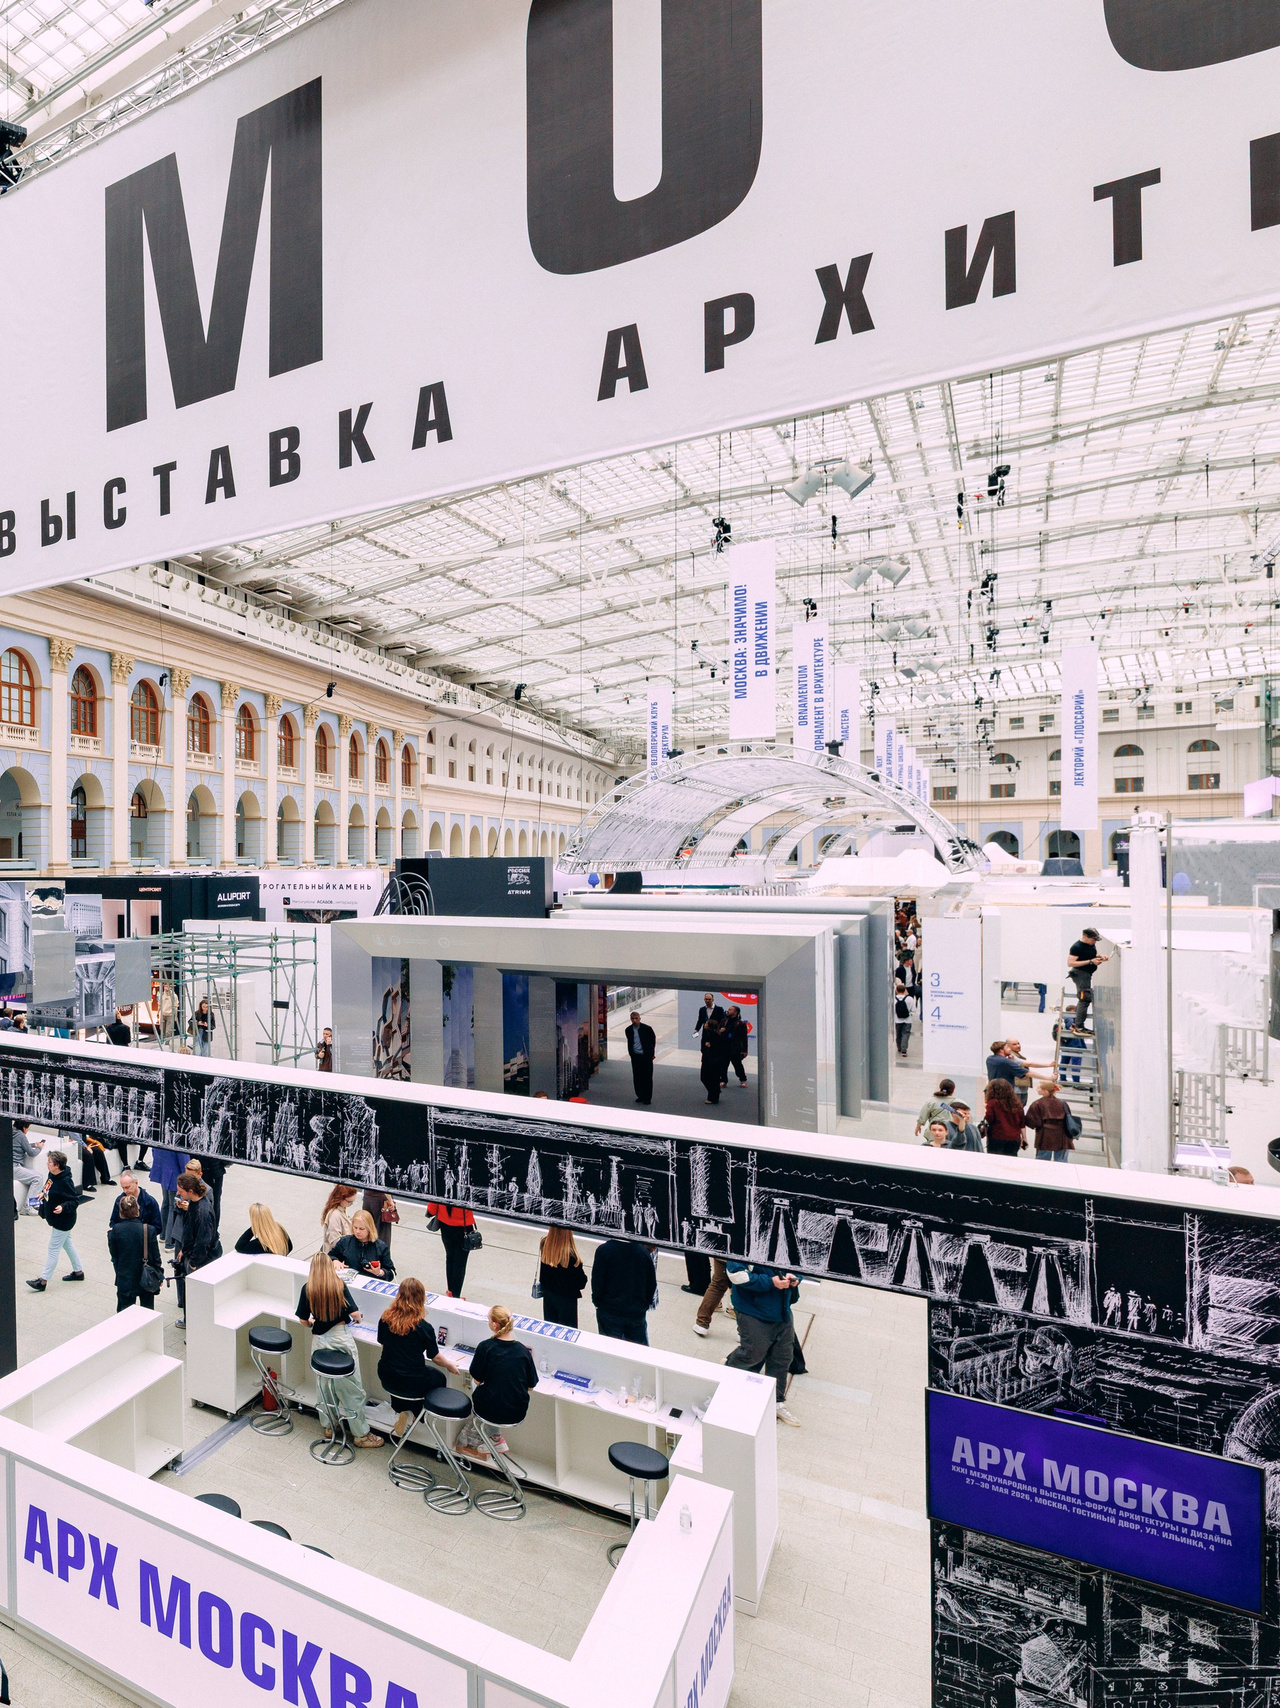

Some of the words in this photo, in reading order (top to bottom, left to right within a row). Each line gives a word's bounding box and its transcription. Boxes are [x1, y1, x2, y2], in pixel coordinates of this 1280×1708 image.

[105, 0, 1280, 433] МО
[733, 584, 748, 645] ЗНАЧИМО!
[754, 600, 771, 667] ДВИЖЕНИИ
[733, 647, 748, 700] МОСКВА:
[754, 669, 769, 678] В
[797, 664, 809, 727] ORNAMENTUM
[813, 637, 825, 695] АРХИТЕКТУРЕ
[813, 696, 825, 704] В
[813, 705, 825, 752] ОРНАМЕНТ
[1072, 746, 1085, 787] ЛЕКТОРИЙ
[217, 891, 251, 902] ALUPORT
[930, 972, 940, 987] 3
[930, 1005, 941, 1020] 4
[951, 1435, 1027, 1482] АРХ
[1042, 1457, 1233, 1537] МОСКВА
[951, 1465, 968, 1475] XXXI
[969, 1470, 1038, 1494] МЕЖДУНАРОДНАЯ
[1039, 1489, 1117, 1515] ВЫСТАВКА-ФОРУМ
[1118, 1510, 1180, 1532] АРХИТЕКТУРЫ
[1181, 1527, 1188, 1535] И
[1190, 1529, 1234, 1547] ДИЗАЙНА
[991, 1484, 1010, 1495] МАЯ
[1034, 1496, 1072, 1514] МОСКВА,
[1072, 1507, 1116, 1525] ГОСТИНЫЙ
[1117, 1518, 1144, 1533] ДВОР,
[1145, 1525, 1161, 1537] УЛ.
[1162, 1531, 1207, 1550] ИЛЬИНКА,
[1208, 1544, 1216, 1552] 4
[23, 1503, 120, 1611] АРХ
[700, 1573, 732, 1697] МОСКВА
